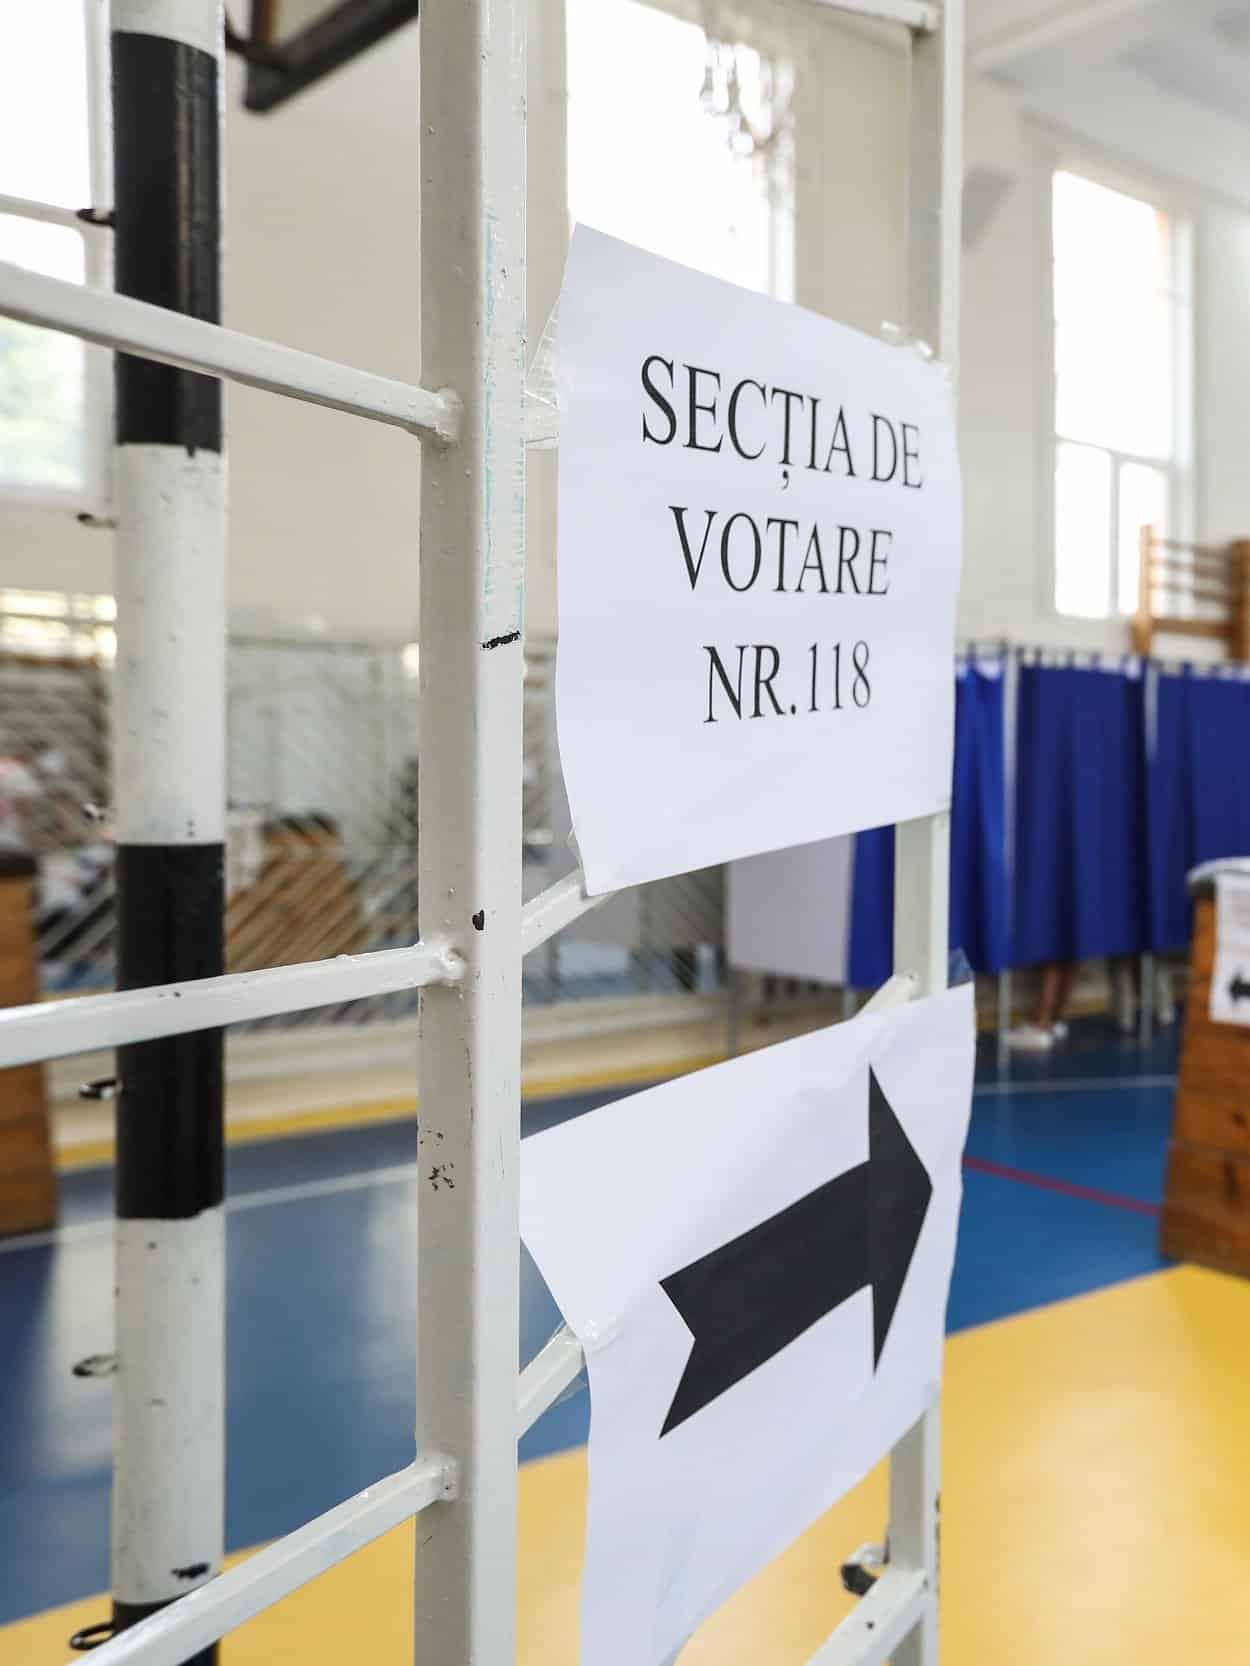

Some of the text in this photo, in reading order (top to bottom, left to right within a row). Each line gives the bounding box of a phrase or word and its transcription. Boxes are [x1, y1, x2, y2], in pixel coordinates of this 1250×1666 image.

[641, 354, 922, 488] SECȚIA DE
[668, 505, 893, 596] VOTARE
